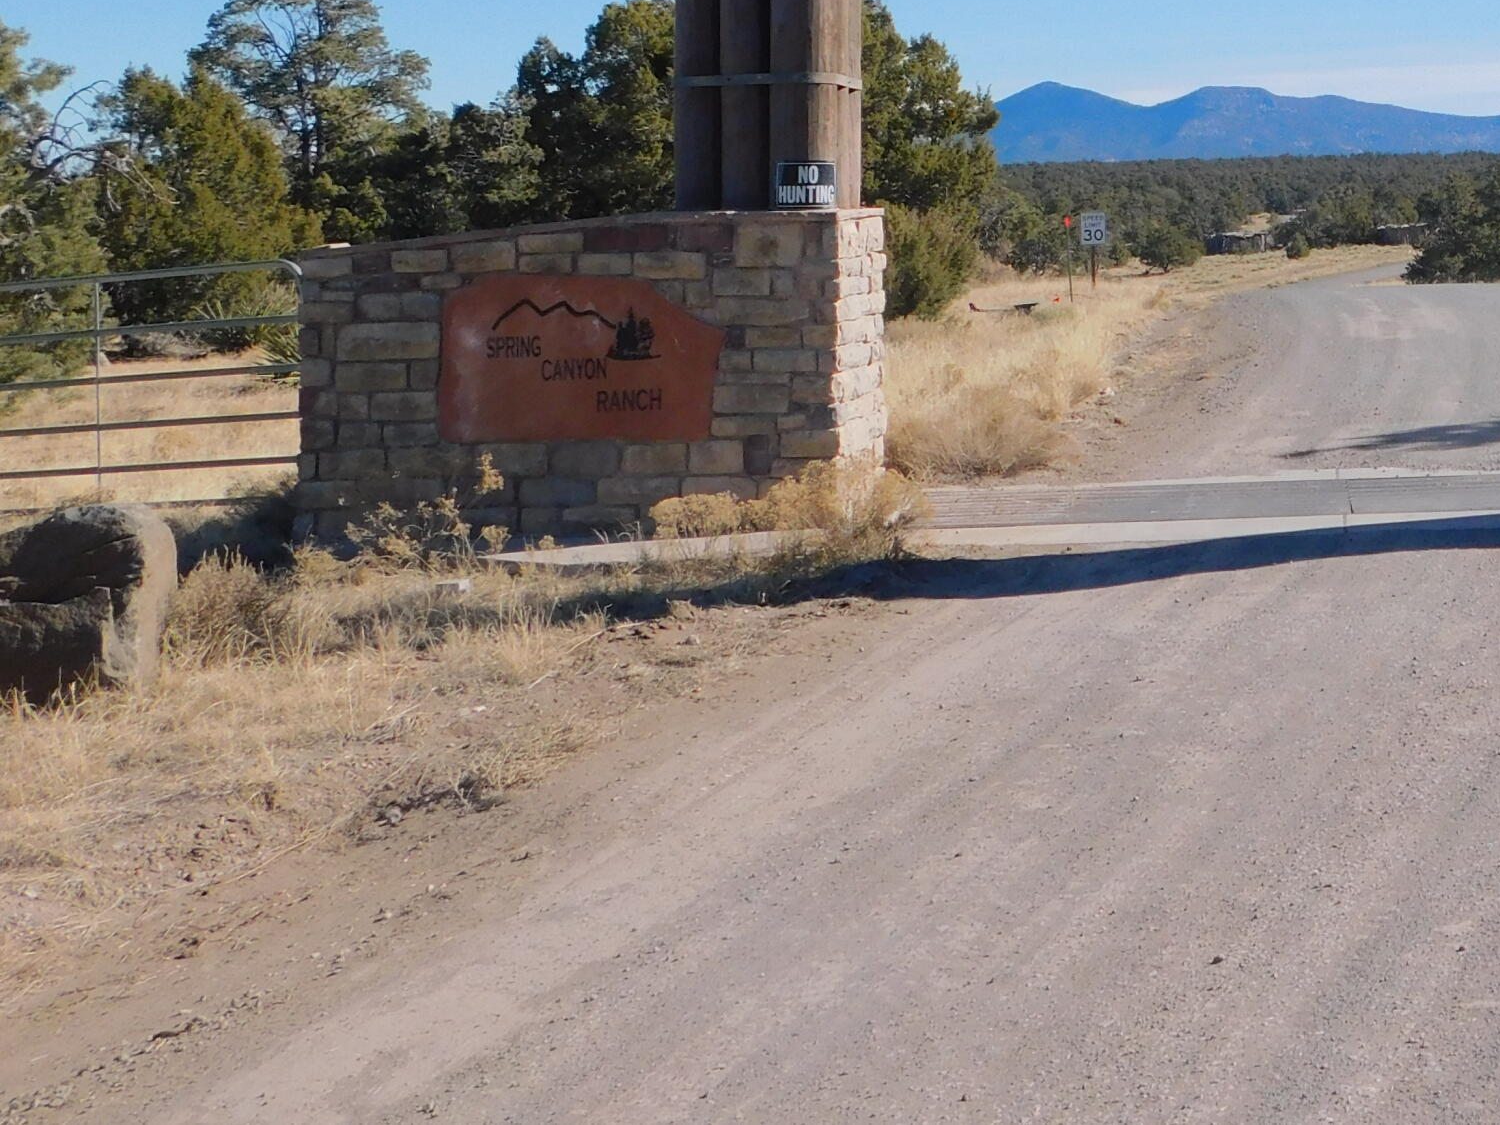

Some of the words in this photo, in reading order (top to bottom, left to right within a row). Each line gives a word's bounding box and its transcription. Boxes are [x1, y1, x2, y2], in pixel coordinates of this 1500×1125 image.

[798, 165, 818, 184] NO
[778, 186, 834, 203] HUNTING
[1083, 229, 1103, 241] 30
[486, 336, 541, 358] SPRING
[541, 357, 607, 381] CANYON
[597, 389, 662, 412] RANCH
